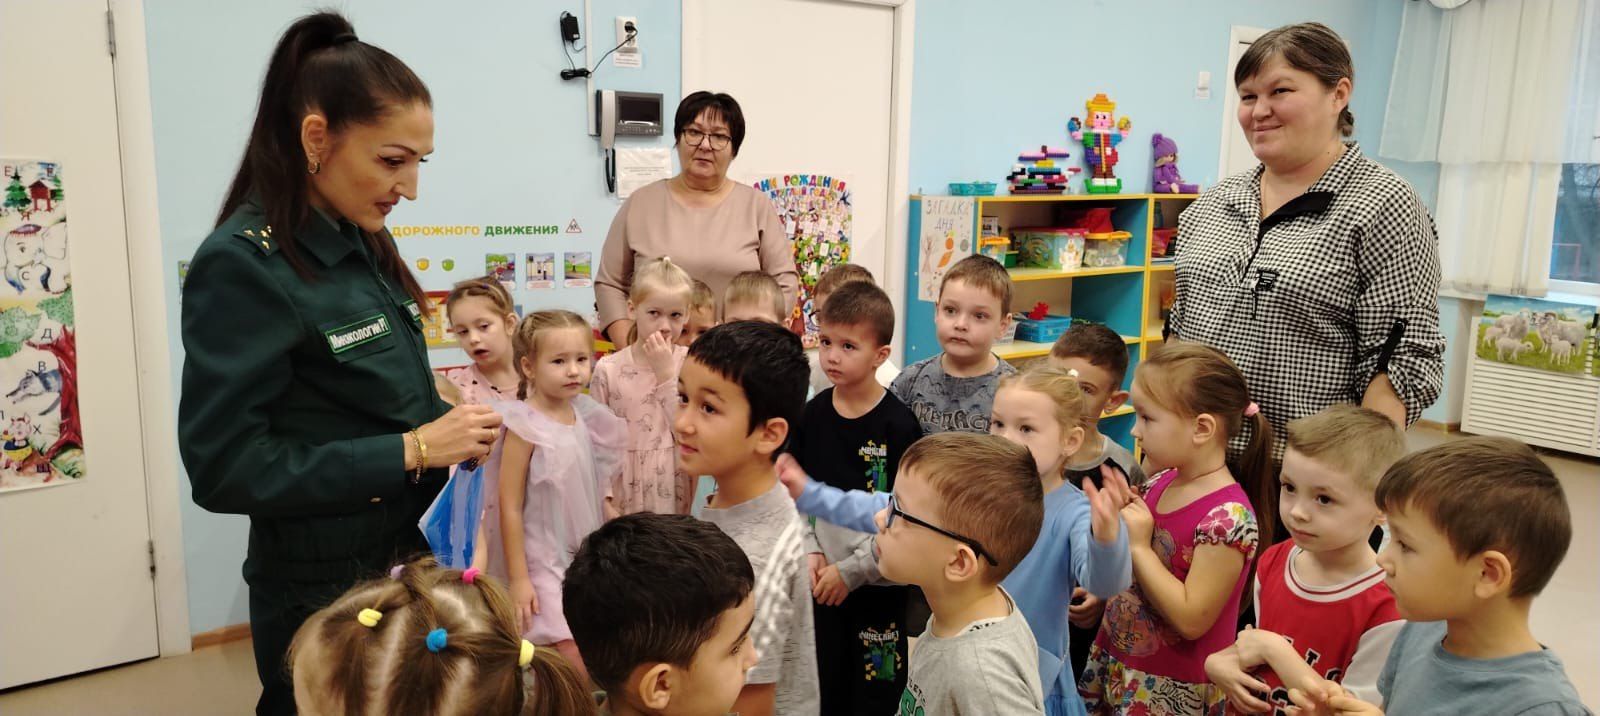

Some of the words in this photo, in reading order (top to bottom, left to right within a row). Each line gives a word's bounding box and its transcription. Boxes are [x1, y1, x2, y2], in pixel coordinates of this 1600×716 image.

[783, 174, 846, 193] РОЖДЕНИЯ
[926, 199, 970, 215] ЗАГАДКА
[392, 225, 480, 237] ДОРОЖНОГО
[484, 225, 559, 237] ДВИЖЕНИЯ
[41, 328, 53, 340] Д
[38, 361, 47, 373] В
